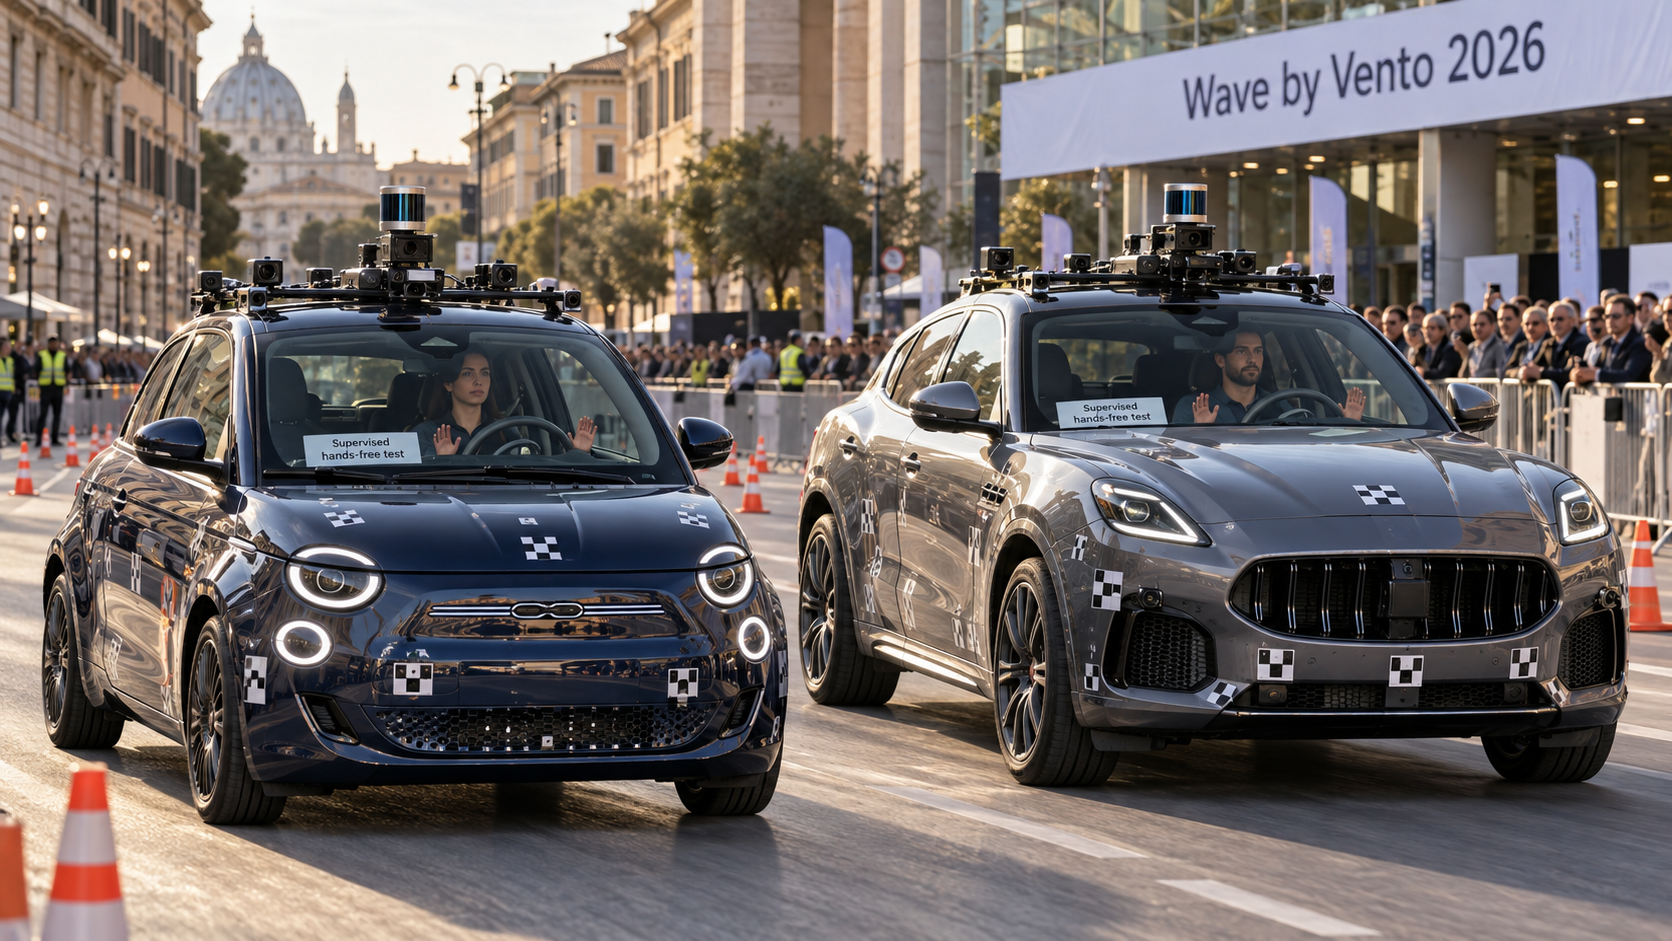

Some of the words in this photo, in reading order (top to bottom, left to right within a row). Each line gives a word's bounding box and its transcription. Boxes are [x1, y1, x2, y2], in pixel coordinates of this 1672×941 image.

[1183, 74, 1270, 120] Wave
[1282, 60, 1321, 116] by
[1331, 46, 1434, 99] Vento
[1448, 20, 1545, 83] 2026
[1083, 402, 1138, 413] Supervised
[1073, 413, 1128, 424] hands-free
[1131, 412, 1151, 421] test
[332, 438, 390, 449] Supervised
[321, 450, 381, 461] hands-free
[383, 450, 405, 459] test
